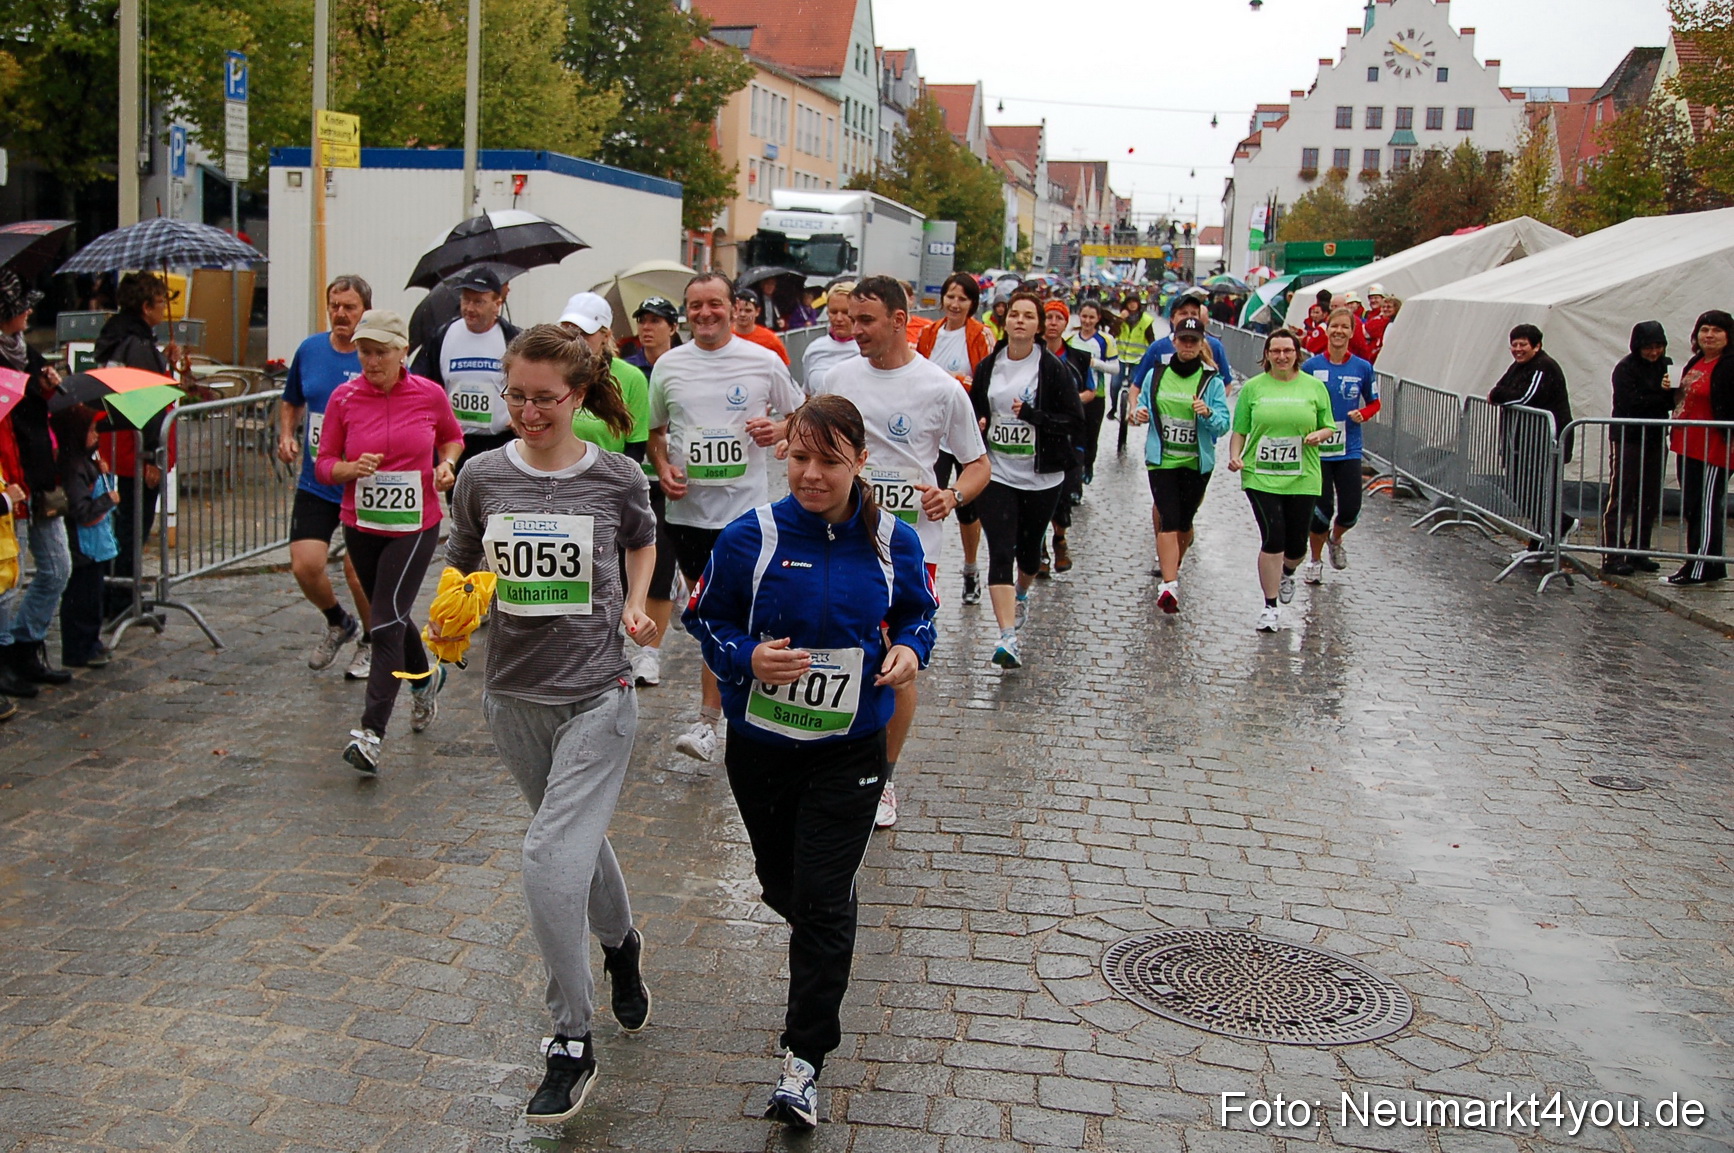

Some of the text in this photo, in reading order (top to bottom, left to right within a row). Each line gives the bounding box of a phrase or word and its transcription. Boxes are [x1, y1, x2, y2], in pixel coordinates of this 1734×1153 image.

[173, 132, 184, 171] P
[452, 393, 489, 412] 5088
[992, 425, 1031, 444] 5042
[1163, 425, 1197, 444] 5155
[690, 440, 742, 464] 5106
[1260, 446, 1298, 461] 5174
[362, 486, 416, 510] 5228
[872, 484, 915, 509] 052
[513, 520, 558, 531] BOCK
[493, 541, 582, 579] 5053
[506, 585, 569, 602] Katharina
[773, 705, 823, 729] Sandra
